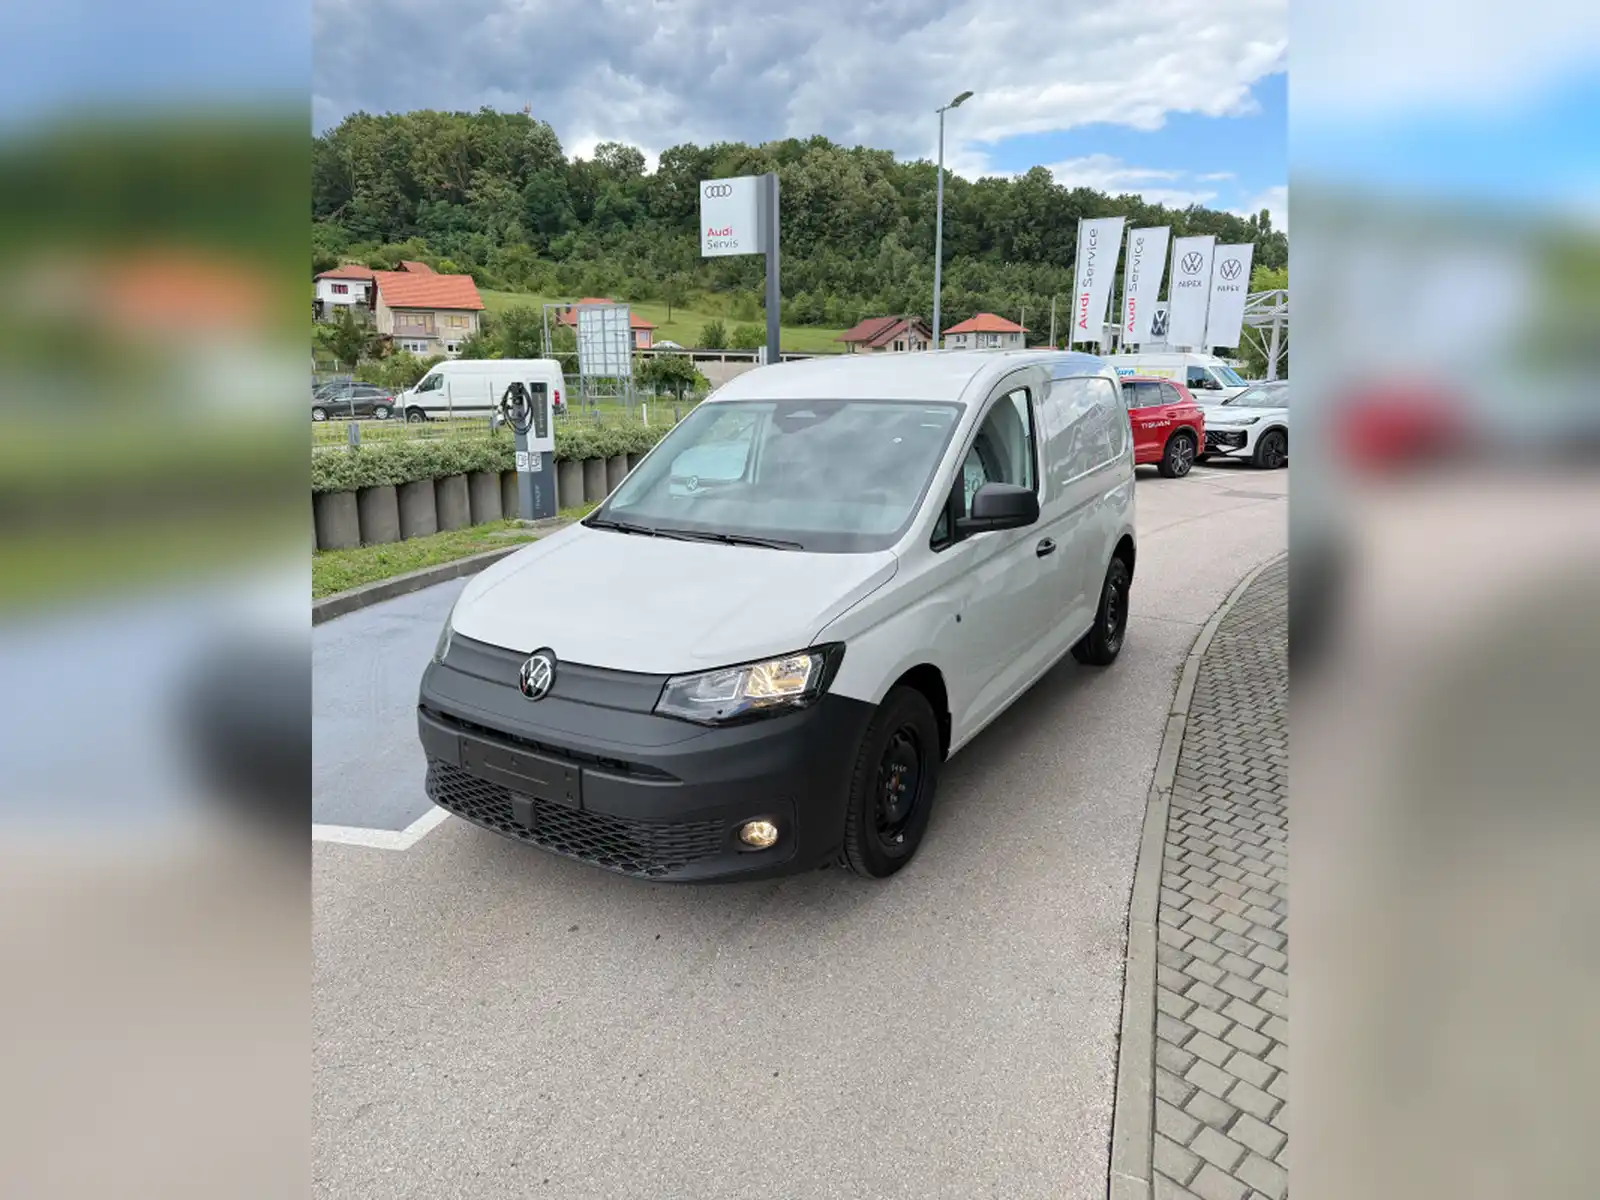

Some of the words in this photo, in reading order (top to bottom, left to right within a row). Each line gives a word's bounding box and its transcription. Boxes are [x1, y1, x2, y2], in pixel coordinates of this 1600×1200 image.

[707, 226, 733, 237] Audi
[707, 239, 739, 250] Servis
[1083, 228, 1099, 288] Service
[1128, 237, 1145, 292] Service
[1079, 292, 1090, 330] Audi
[1127, 297, 1136, 333] Audi
